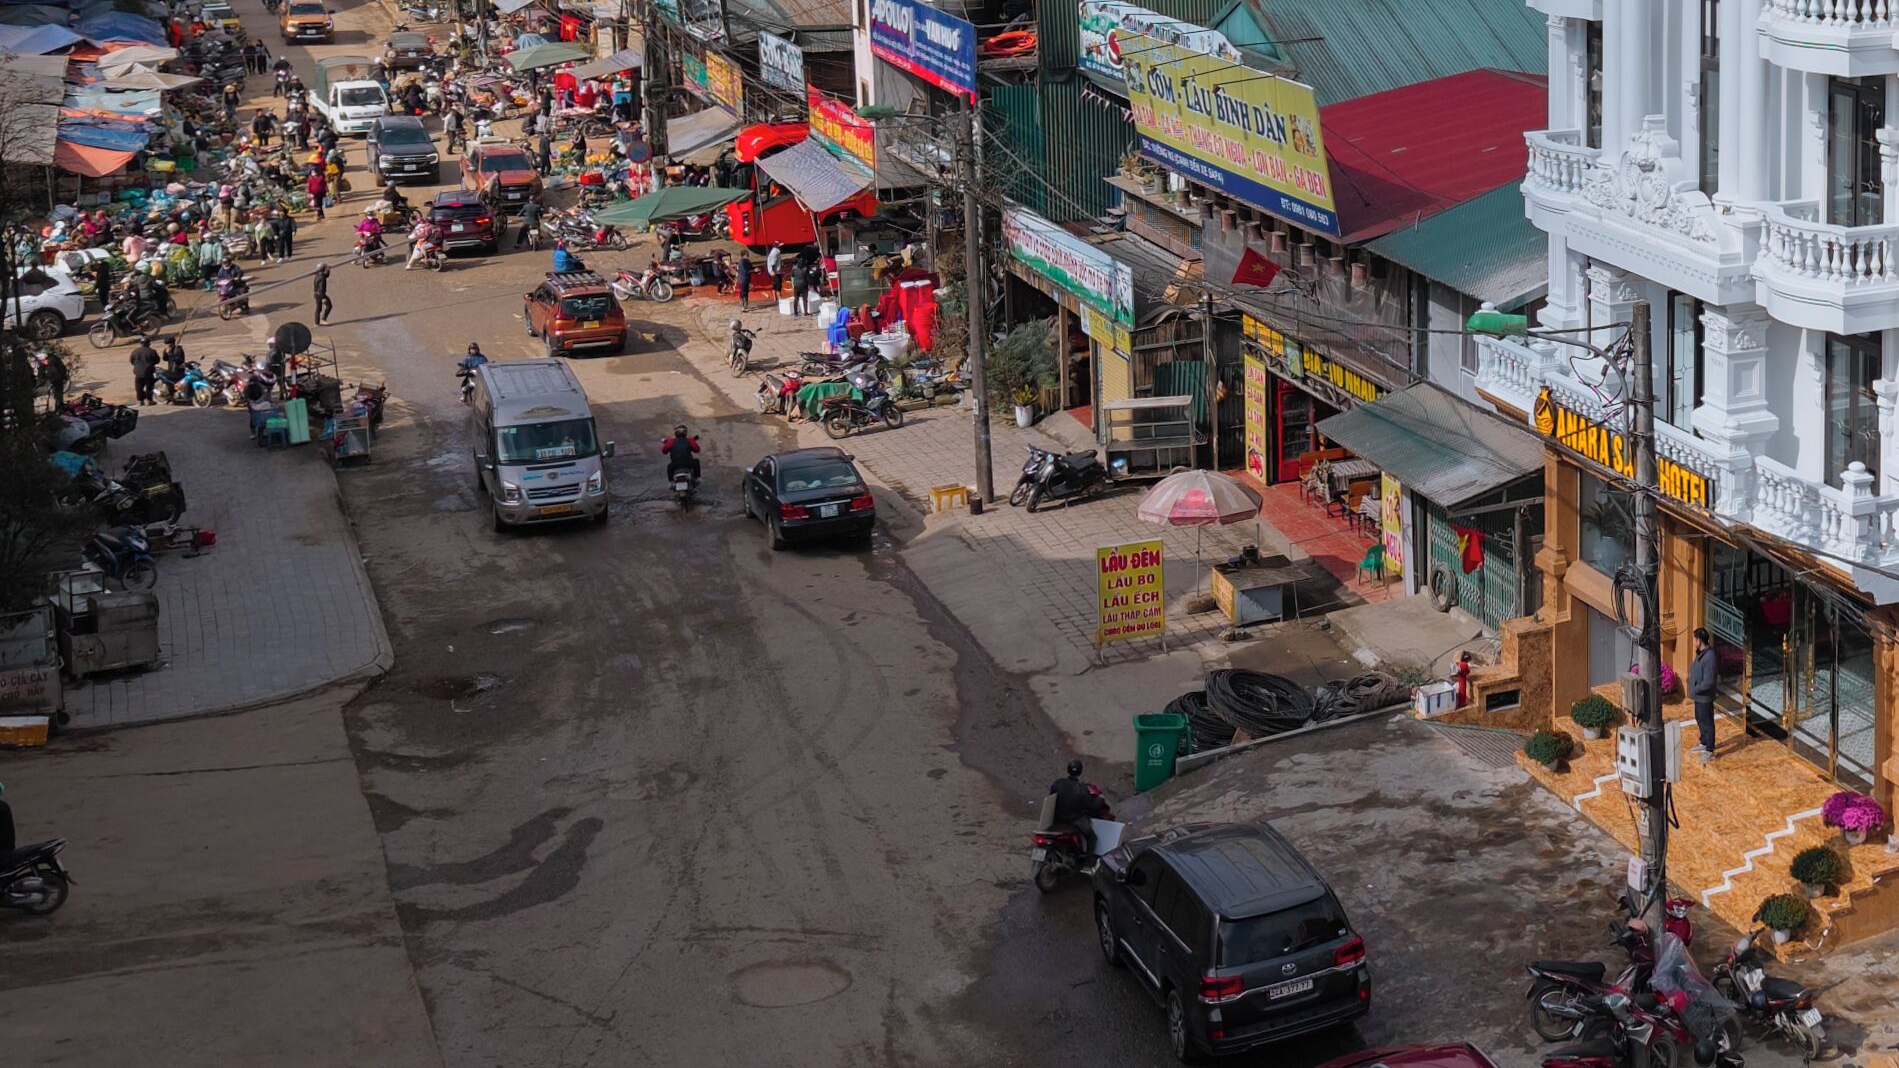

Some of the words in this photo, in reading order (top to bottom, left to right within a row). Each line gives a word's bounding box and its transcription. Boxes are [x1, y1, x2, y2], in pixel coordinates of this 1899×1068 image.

[1253, 102, 1288, 145] DÂN
[1556, 407, 1609, 467] ANARA
[1658, 458, 1709, 516] HOTEL
[1102, 547, 1128, 573] LẨU
[1130, 547, 1161, 569] ĐÊM
